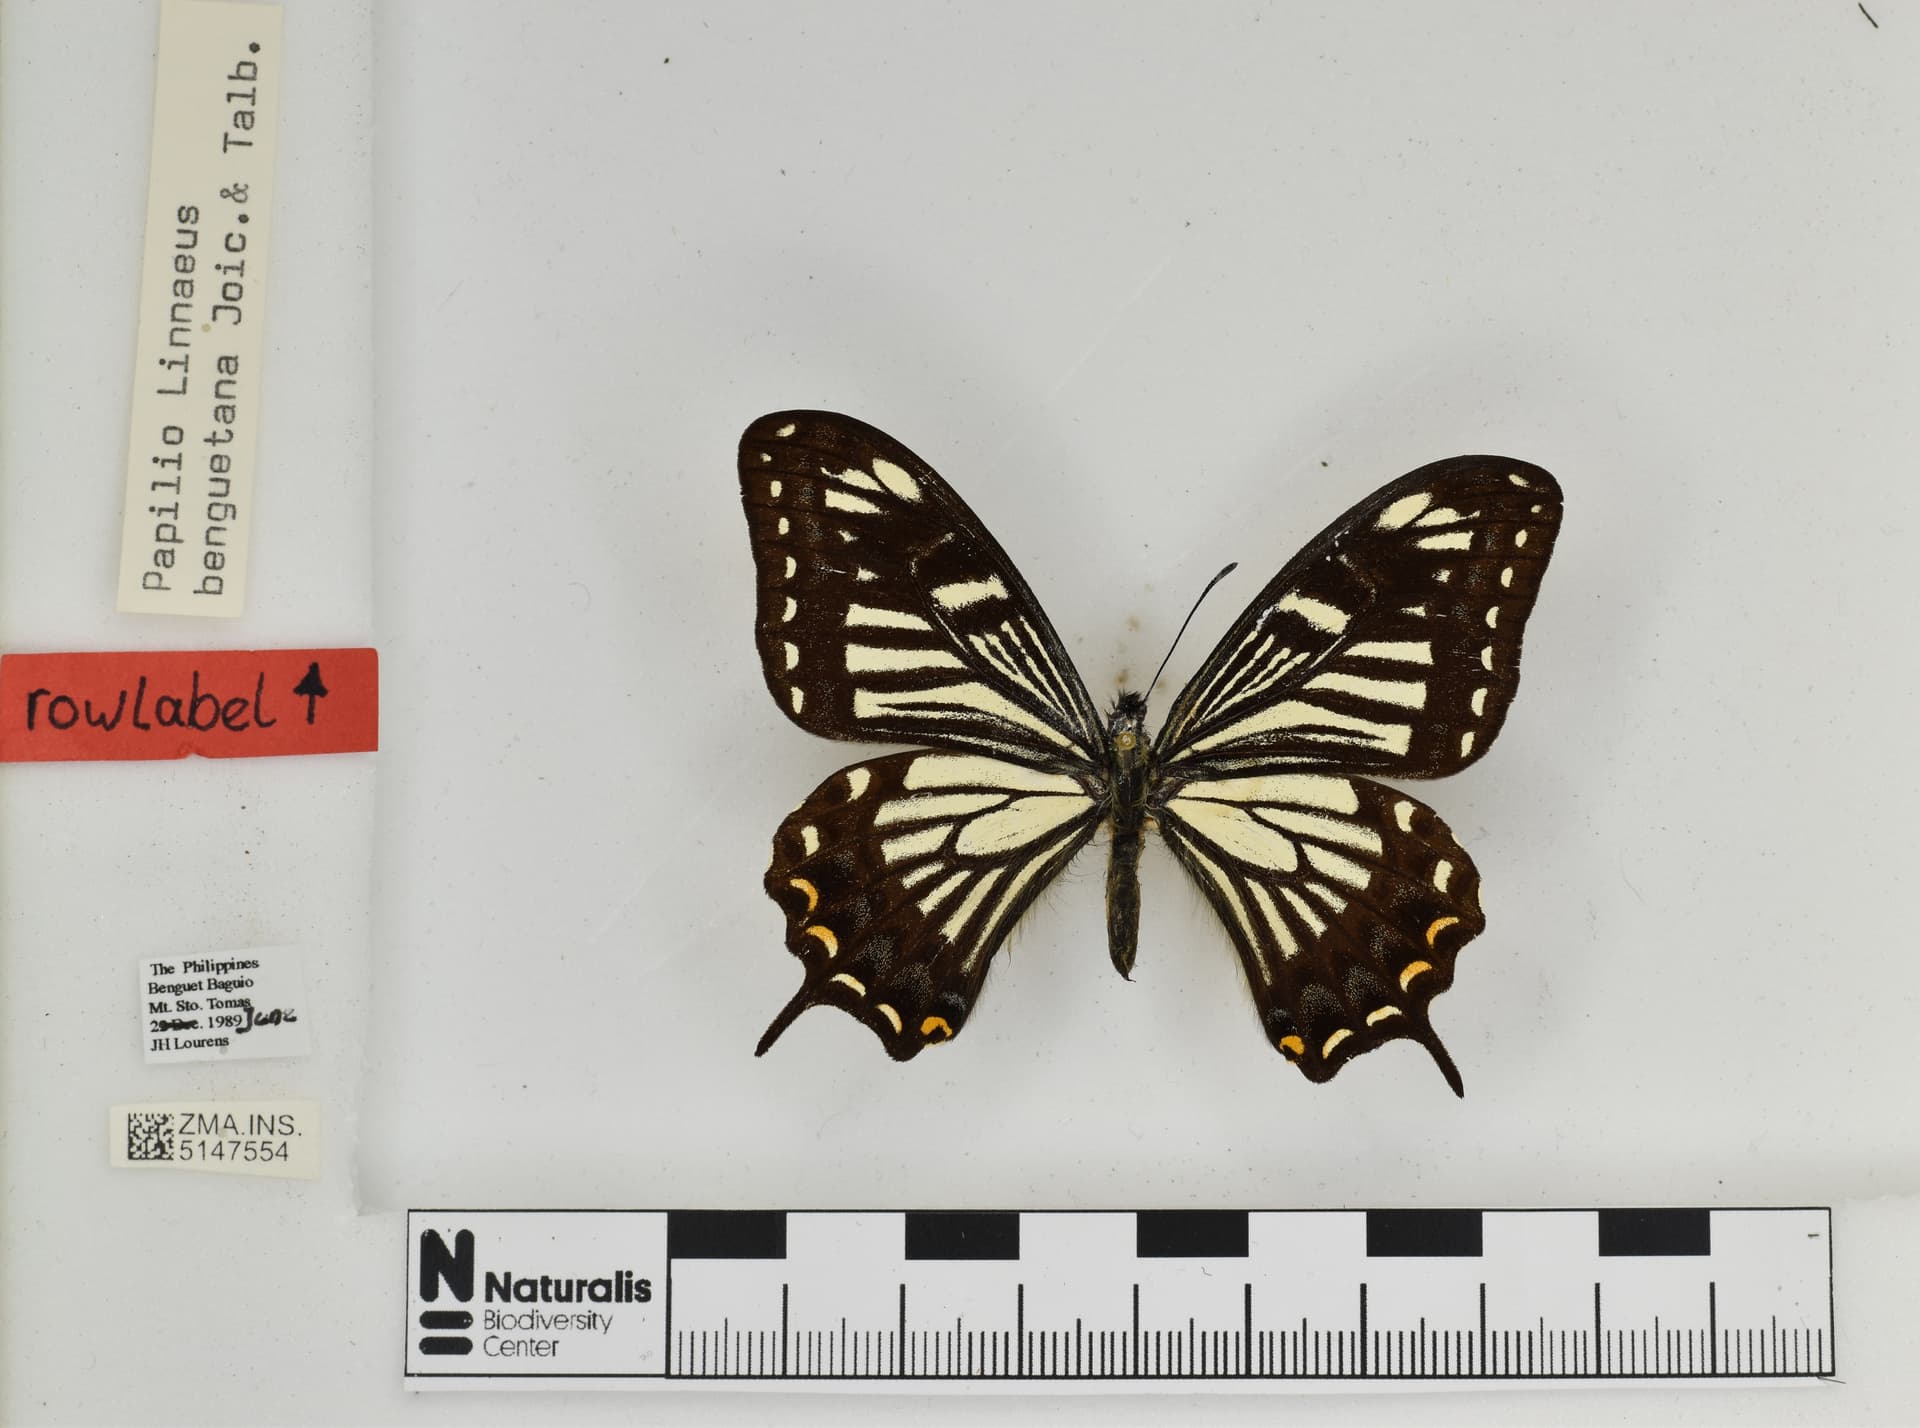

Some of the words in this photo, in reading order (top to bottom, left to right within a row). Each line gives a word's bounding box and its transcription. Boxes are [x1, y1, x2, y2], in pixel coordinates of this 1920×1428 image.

[156, 203, 200, 397] Linnaeus
[194, 353, 240, 597] benguetana
[222, 41, 262, 154] Talb.
[142, 424, 185, 592] Papilio
[150, 963, 175, 976] The
[183, 957, 260, 974] Philippines
[148, 980, 203, 996] Benguet
[207, 975, 254, 993] Baguio
[149, 1001, 172, 1014] Mt.
[176, 1000, 203, 1012] Sto.
[207, 997, 252, 1010] Tomas
[208, 1014, 242, 1029] 1989
[151, 1038, 171, 1052] JH
[174, 1036, 230, 1050] Lourens
[178, 1113, 302, 1136] ZMA.INS.
[179, 1140, 290, 1162] 5147554
[484, 1270, 652, 1303] Naturalis
[483, 1309, 613, 1335] Biodiversity
[483, 1335, 560, 1357] Center
